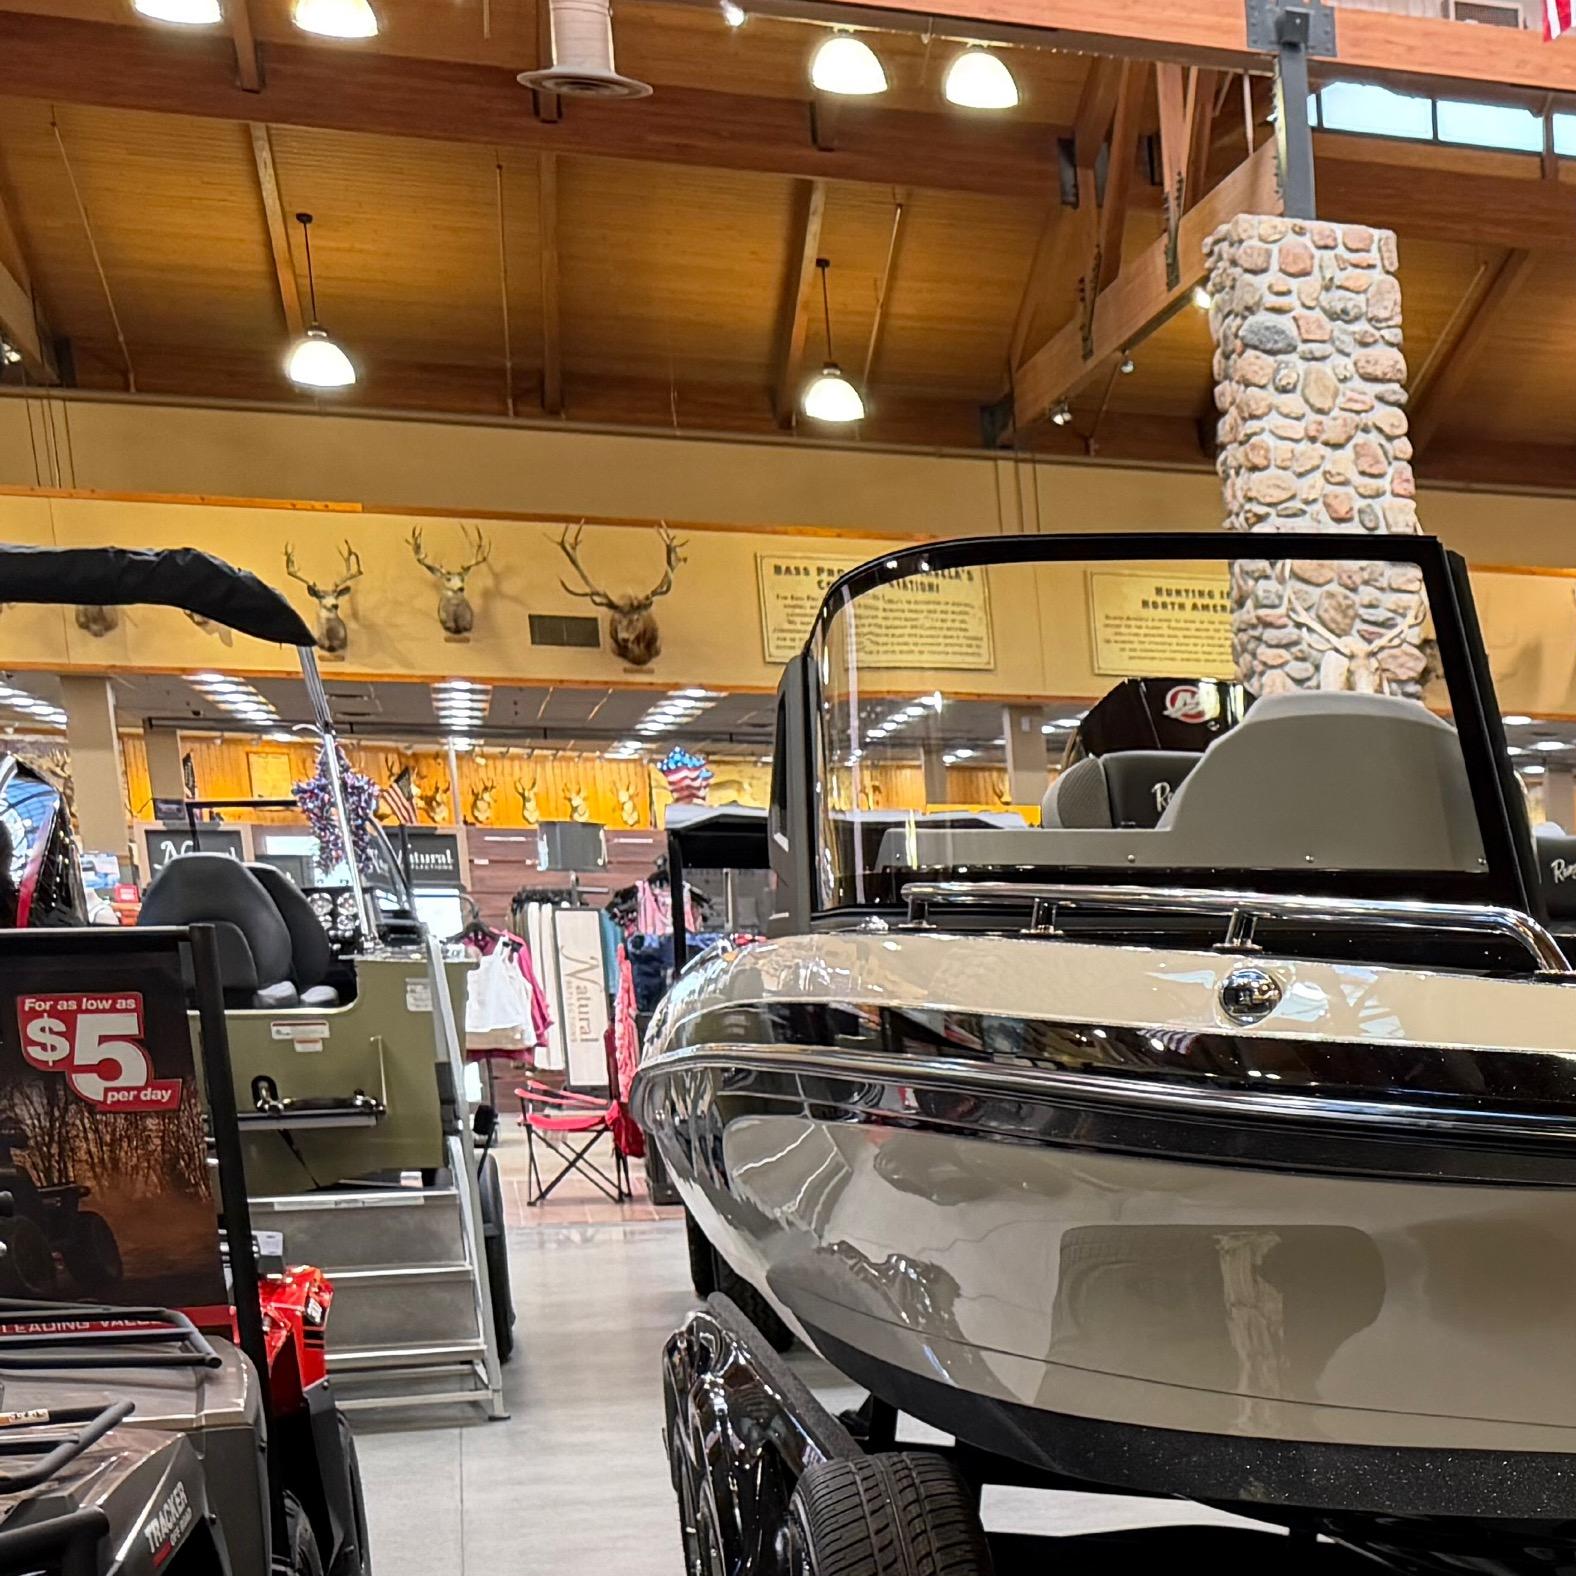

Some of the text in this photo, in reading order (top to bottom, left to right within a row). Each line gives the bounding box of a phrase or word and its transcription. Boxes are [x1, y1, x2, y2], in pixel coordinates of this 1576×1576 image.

[1191, 602, 1232, 614] AMER
[24, 997, 136, 1011] For as low as
[26, 1012, 148, 1102] $5
[106, 1087, 172, 1104] per day
[144, 1481, 188, 1554] TRACKER
